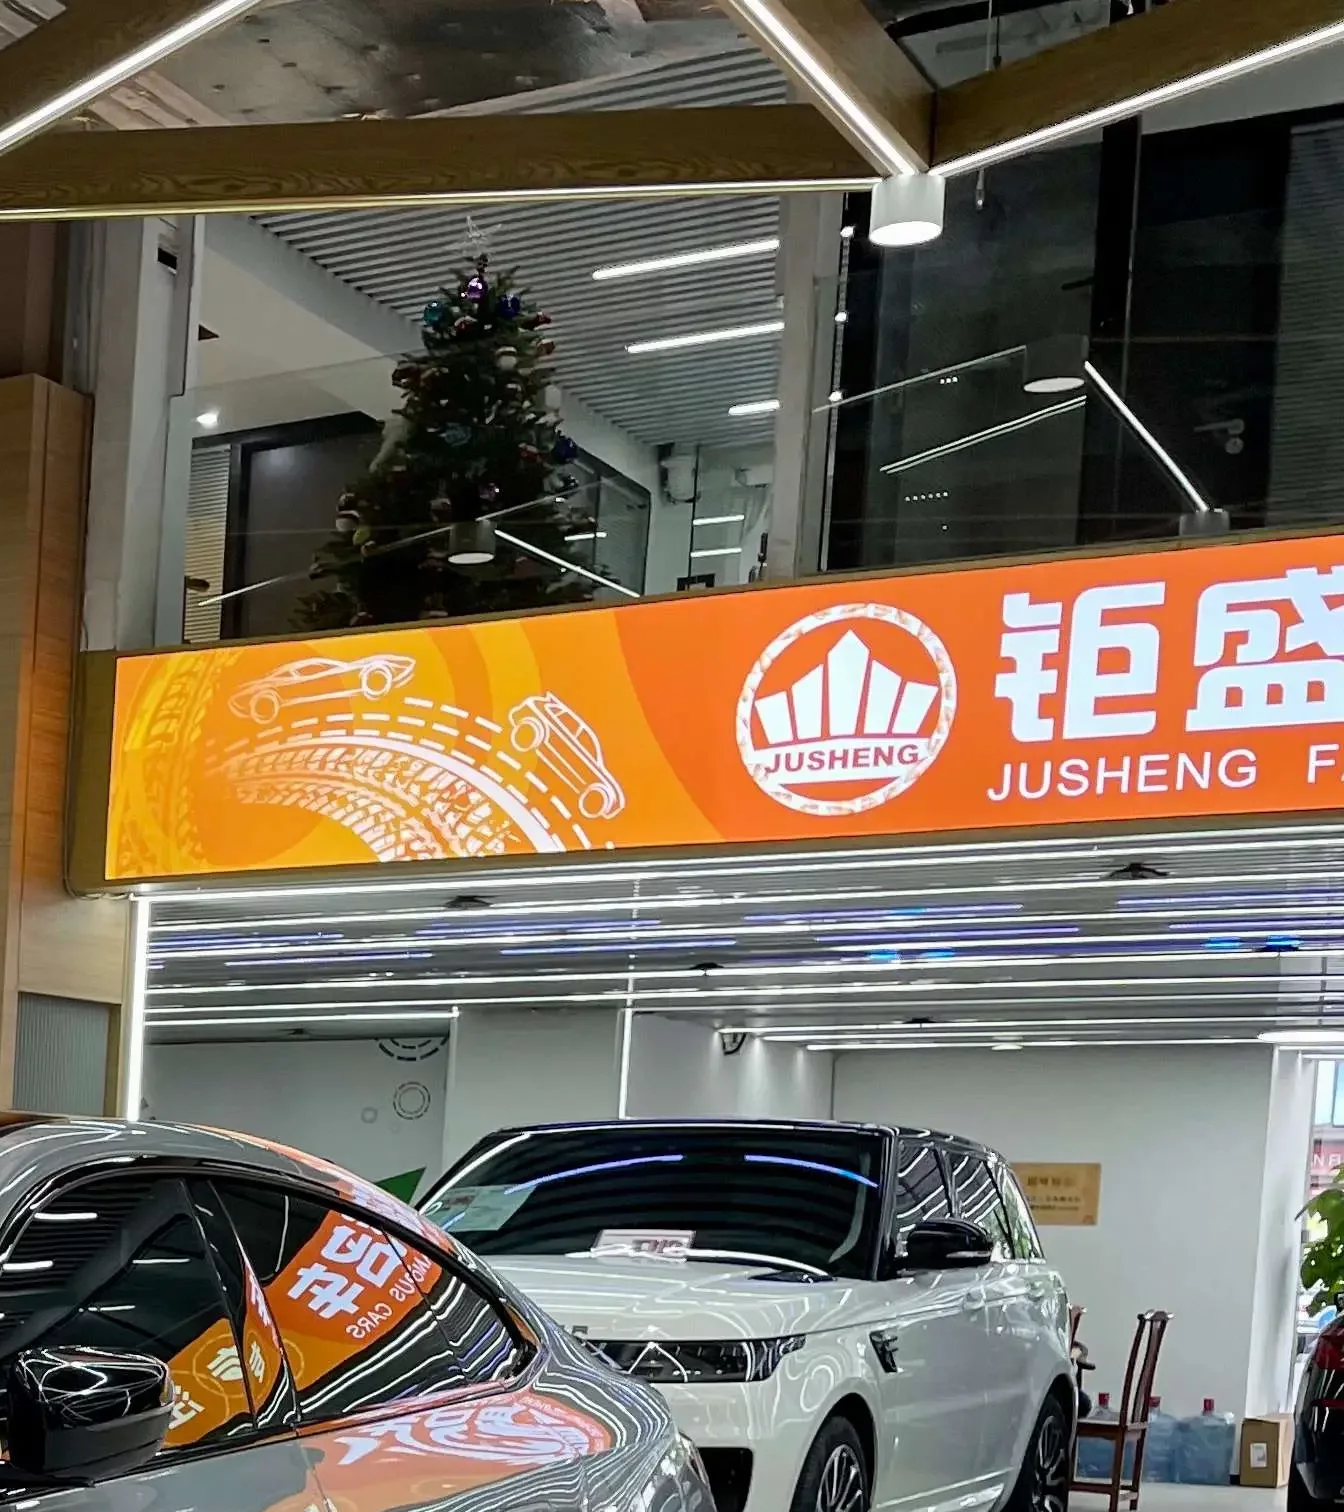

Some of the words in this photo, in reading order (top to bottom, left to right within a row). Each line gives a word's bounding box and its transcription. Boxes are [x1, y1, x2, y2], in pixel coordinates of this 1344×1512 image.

[765, 742, 920, 775] JUSHENG
[986, 747, 1259, 801] JUSHENG
[1308, 743, 1344, 785] F
